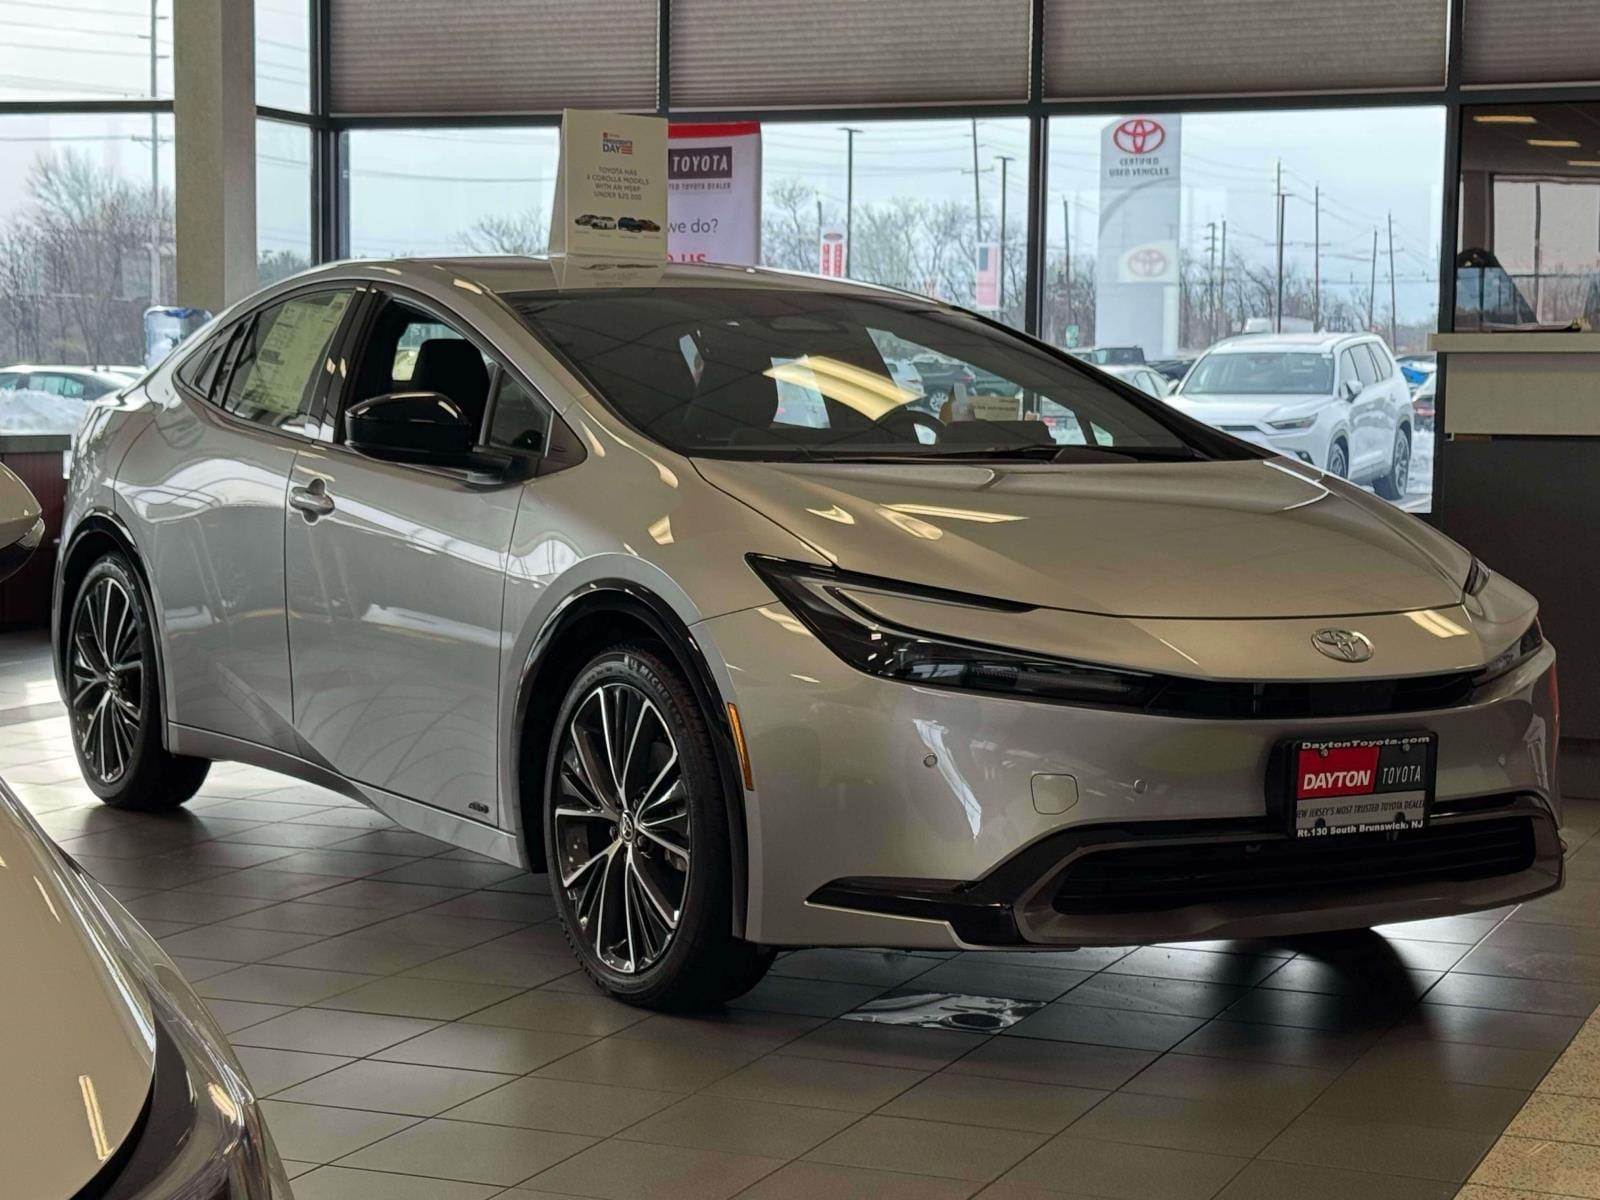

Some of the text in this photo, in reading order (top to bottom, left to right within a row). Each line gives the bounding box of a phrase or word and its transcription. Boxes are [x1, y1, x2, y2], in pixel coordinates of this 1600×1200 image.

[603, 144, 620, 153] DAY
[598, 166, 623, 175] TOYOTA
[672, 155, 728, 172] TOYOTA
[1132, 167, 1169, 176] VEHICLES
[592, 174, 622, 182] COROLLA
[623, 177, 649, 185] MODELS
[691, 218, 718, 233] do?
[1301, 736, 1430, 750] DaytonToyota.com
[1303, 765, 1421, 791] DAYTON TOYOTA
[1309, 806, 1334, 818] JERSEY'S
[1336, 805, 1353, 815] MOST
[1354, 803, 1380, 813] TRUSTED
[1381, 802, 1402, 811] TOYOTA
[1330, 824, 1357, 835] South
[1359, 821, 1409, 832] Brunswick,
[1411, 820, 1424, 829] NJ
